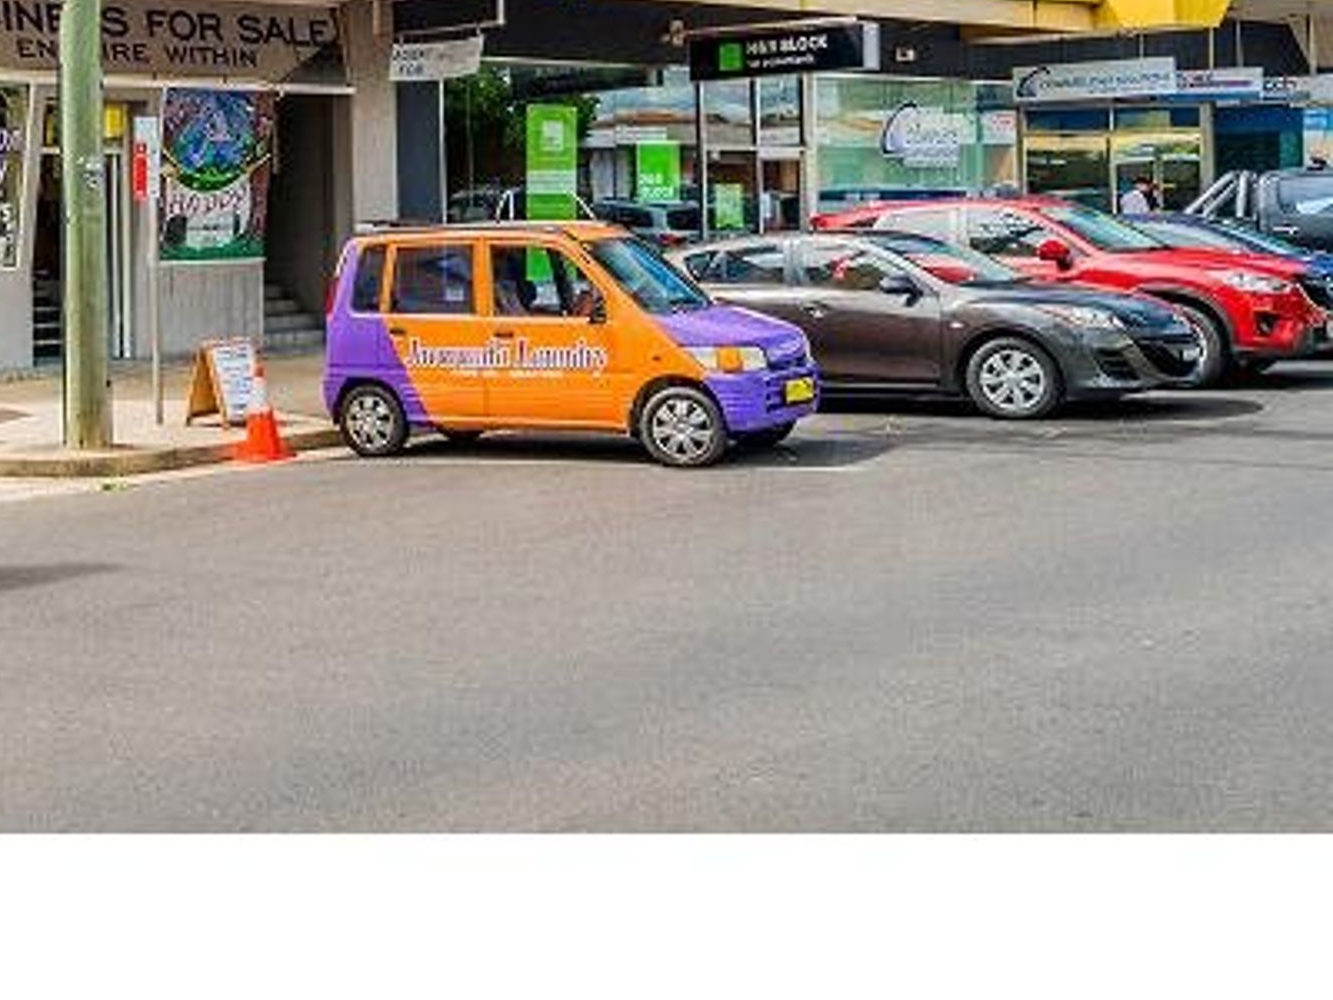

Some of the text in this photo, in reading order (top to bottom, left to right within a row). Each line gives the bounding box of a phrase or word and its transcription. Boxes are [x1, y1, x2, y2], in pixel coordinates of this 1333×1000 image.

[146, 10, 222, 42] FOR
[237, 14, 332, 47] SALE
[779, 34, 828, 52] BLOCK
[18, 38, 258, 67] ENIRE WITHIN
